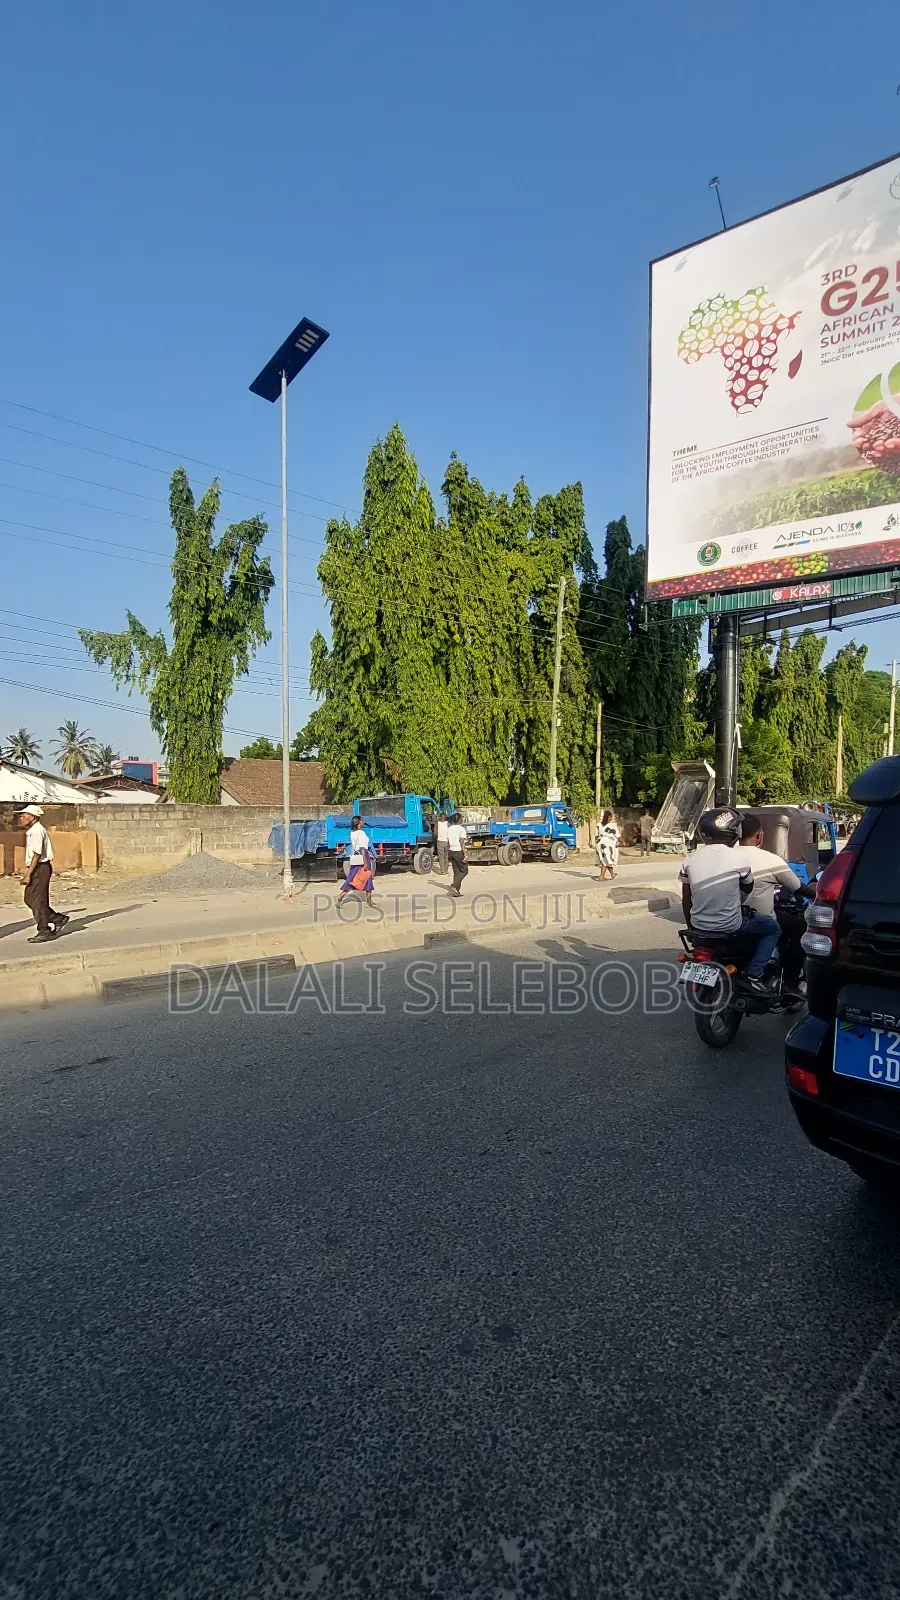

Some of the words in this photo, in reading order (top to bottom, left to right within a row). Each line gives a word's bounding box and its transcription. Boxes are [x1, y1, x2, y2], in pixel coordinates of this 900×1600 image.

[821, 264, 857, 286] 3RD
[821, 260, 900, 316] G2
[820, 303, 894, 335] AFRICAN
[820, 319, 887, 348] SUMMIT
[853, 335, 886, 349] February
[842, 351, 855, 360] Dar
[672, 455, 711, 470] UNLOCKING
[711, 441, 759, 460] EMPLOYMENT
[760, 426, 820, 446] OPPORTUNITIES
[672, 444, 698, 457] THEME
[672, 469, 684, 477] FOR
[686, 465, 698, 473] THE
[700, 457, 723, 468] YOUTH
[724, 448, 759, 463] THROUGH
[760, 433, 818, 453] REGENERATION
[681, 472, 694, 481] THE
[695, 465, 725, 478] AFRICAN
[726, 457, 753, 469] COFFEE
[754, 447, 791, 462] INDUSTRY
[732, 542, 758, 554] COFFEE
[776, 525, 835, 543] AJENDA
[790, 584, 832, 599] KALAX
[871, 1028, 900, 1056] T2
[868, 1054, 900, 1083] CD
